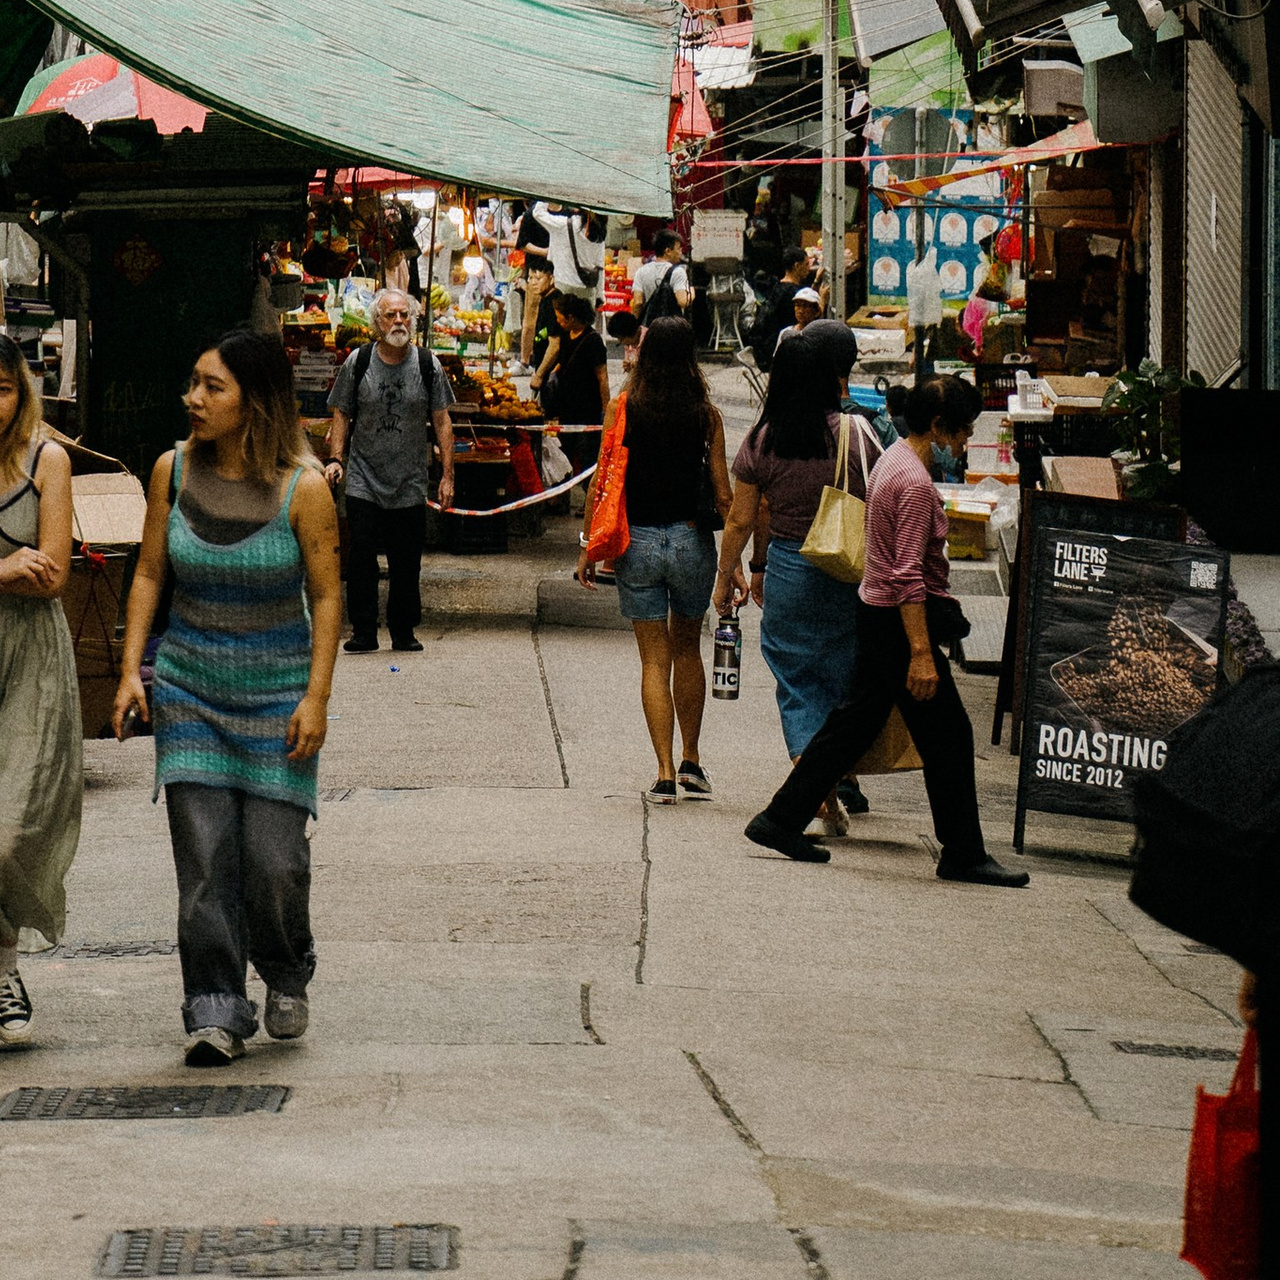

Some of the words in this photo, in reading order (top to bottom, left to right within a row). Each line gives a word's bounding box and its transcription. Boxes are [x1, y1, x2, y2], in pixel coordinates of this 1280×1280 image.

[1055, 541, 1108, 565] FILTERS
[1053, 559, 1089, 581] LANE
[713, 671, 737, 686] TIC
[1038, 724, 1168, 771] ROASTING
[1035, 758, 1083, 783] SINCE
[1085, 765, 1124, 789] 2012
